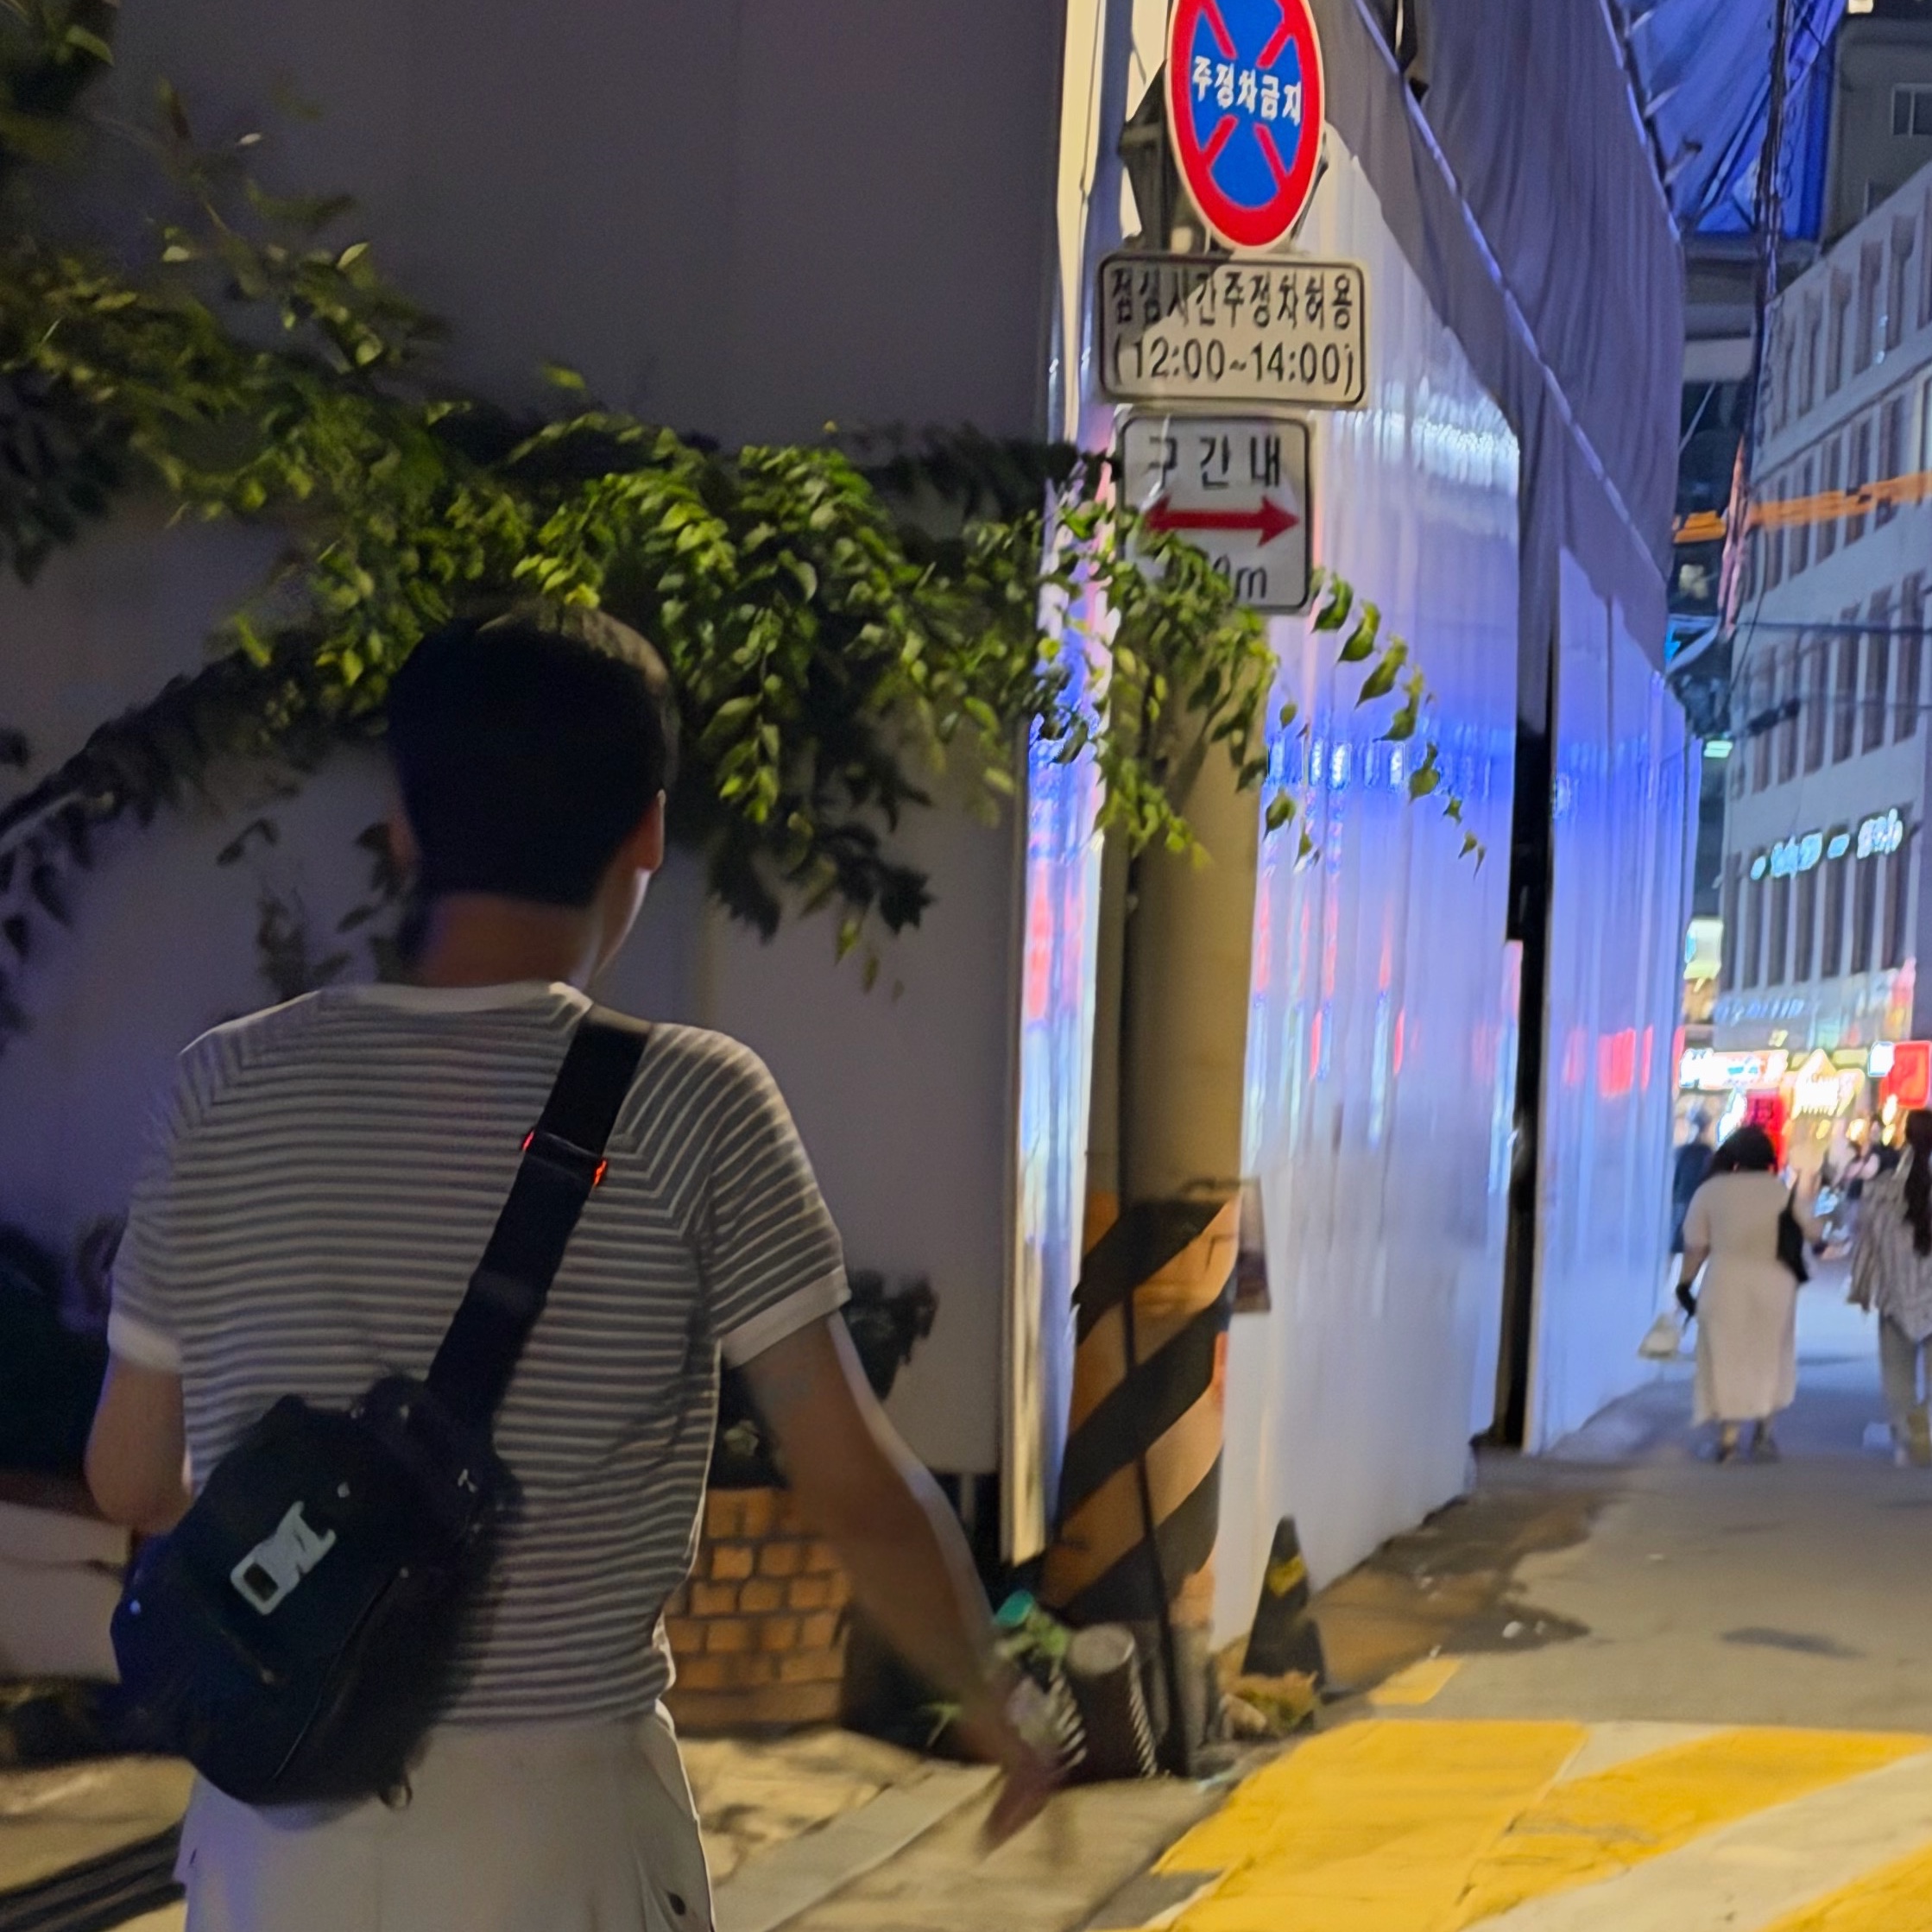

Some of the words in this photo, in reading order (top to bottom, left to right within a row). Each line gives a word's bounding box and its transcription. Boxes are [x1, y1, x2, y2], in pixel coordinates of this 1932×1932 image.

[1191, 55, 1302, 126] 주정차금지
[1113, 267, 1353, 330] 점심시간주정차허용
[1113, 334, 1354, 397] (12:00~14:00)
